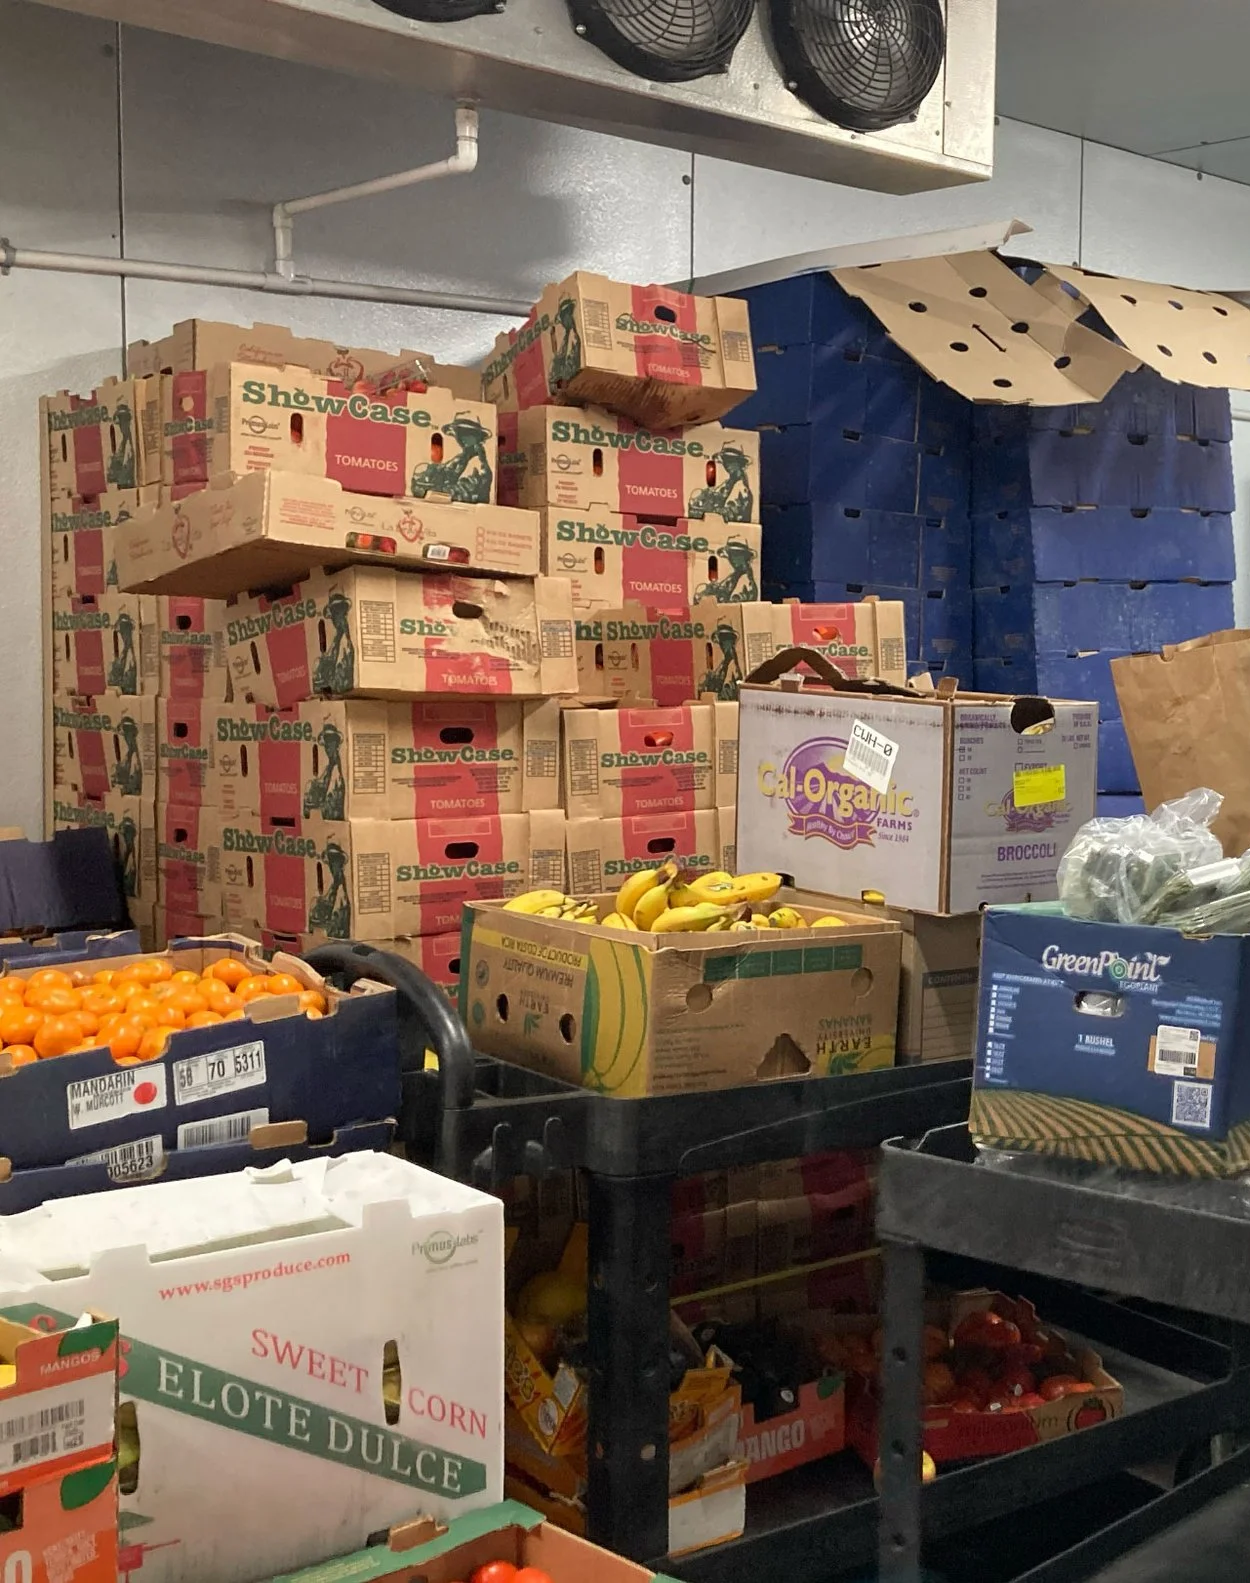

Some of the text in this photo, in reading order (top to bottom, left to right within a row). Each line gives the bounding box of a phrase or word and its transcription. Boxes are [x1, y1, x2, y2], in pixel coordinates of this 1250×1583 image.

[616, 313, 711, 345] ShowCase
[242, 380, 432, 427] ShowCase
[552, 421, 704, 457] ShowCase
[335, 454, 399, 473] TOMATOES
[626, 485, 678, 499] TOMATOES
[557, 521, 709, 552] ShowCase
[629, 581, 682, 594] TOMATOES
[227, 598, 317, 645] ShowCase
[606, 616, 705, 640] ShowCase
[217, 714, 314, 742] ShowCase
[391, 746, 514, 764] ShowCase
[601, 750, 708, 768] ShowCase
[758, 761, 914, 818] Cal-Organic
[430, 798, 486, 810] TOMATOES
[635, 796, 684, 809] TOMATOES
[877, 818, 913, 831] FARMS
[223, 827, 317, 856] ShowCase
[997, 843, 1057, 862] BROCCOLI
[396, 860, 520, 882] ShowCase
[501, 936, 516, 950] RICA
[517, 940, 538, 956] COSTA
[546, 949, 582, 967] PRODUCT
[1042, 944, 1171, 982] GreenPoint
[518, 997, 550, 1014] EARTH
[819, 1014, 872, 1029] BANANAS
[816, 1036, 872, 1055] EARTH
[208, 1060, 226, 1081] 70
[234, 1050, 262, 1074] 5311
[71, 1071, 136, 1099] MANDARIN
[86, 1092, 124, 1113] MURCOTT
[159, 1252, 351, 1300] www.sgsproduce.com
[40, 1351, 101, 1376] MANGOS
[252, 1328, 369, 1394] SWEET
[158, 1357, 312, 1442] ELOTE
[409, 1387, 487, 1439] CORN
[328, 1415, 462, 1493] DULCE
